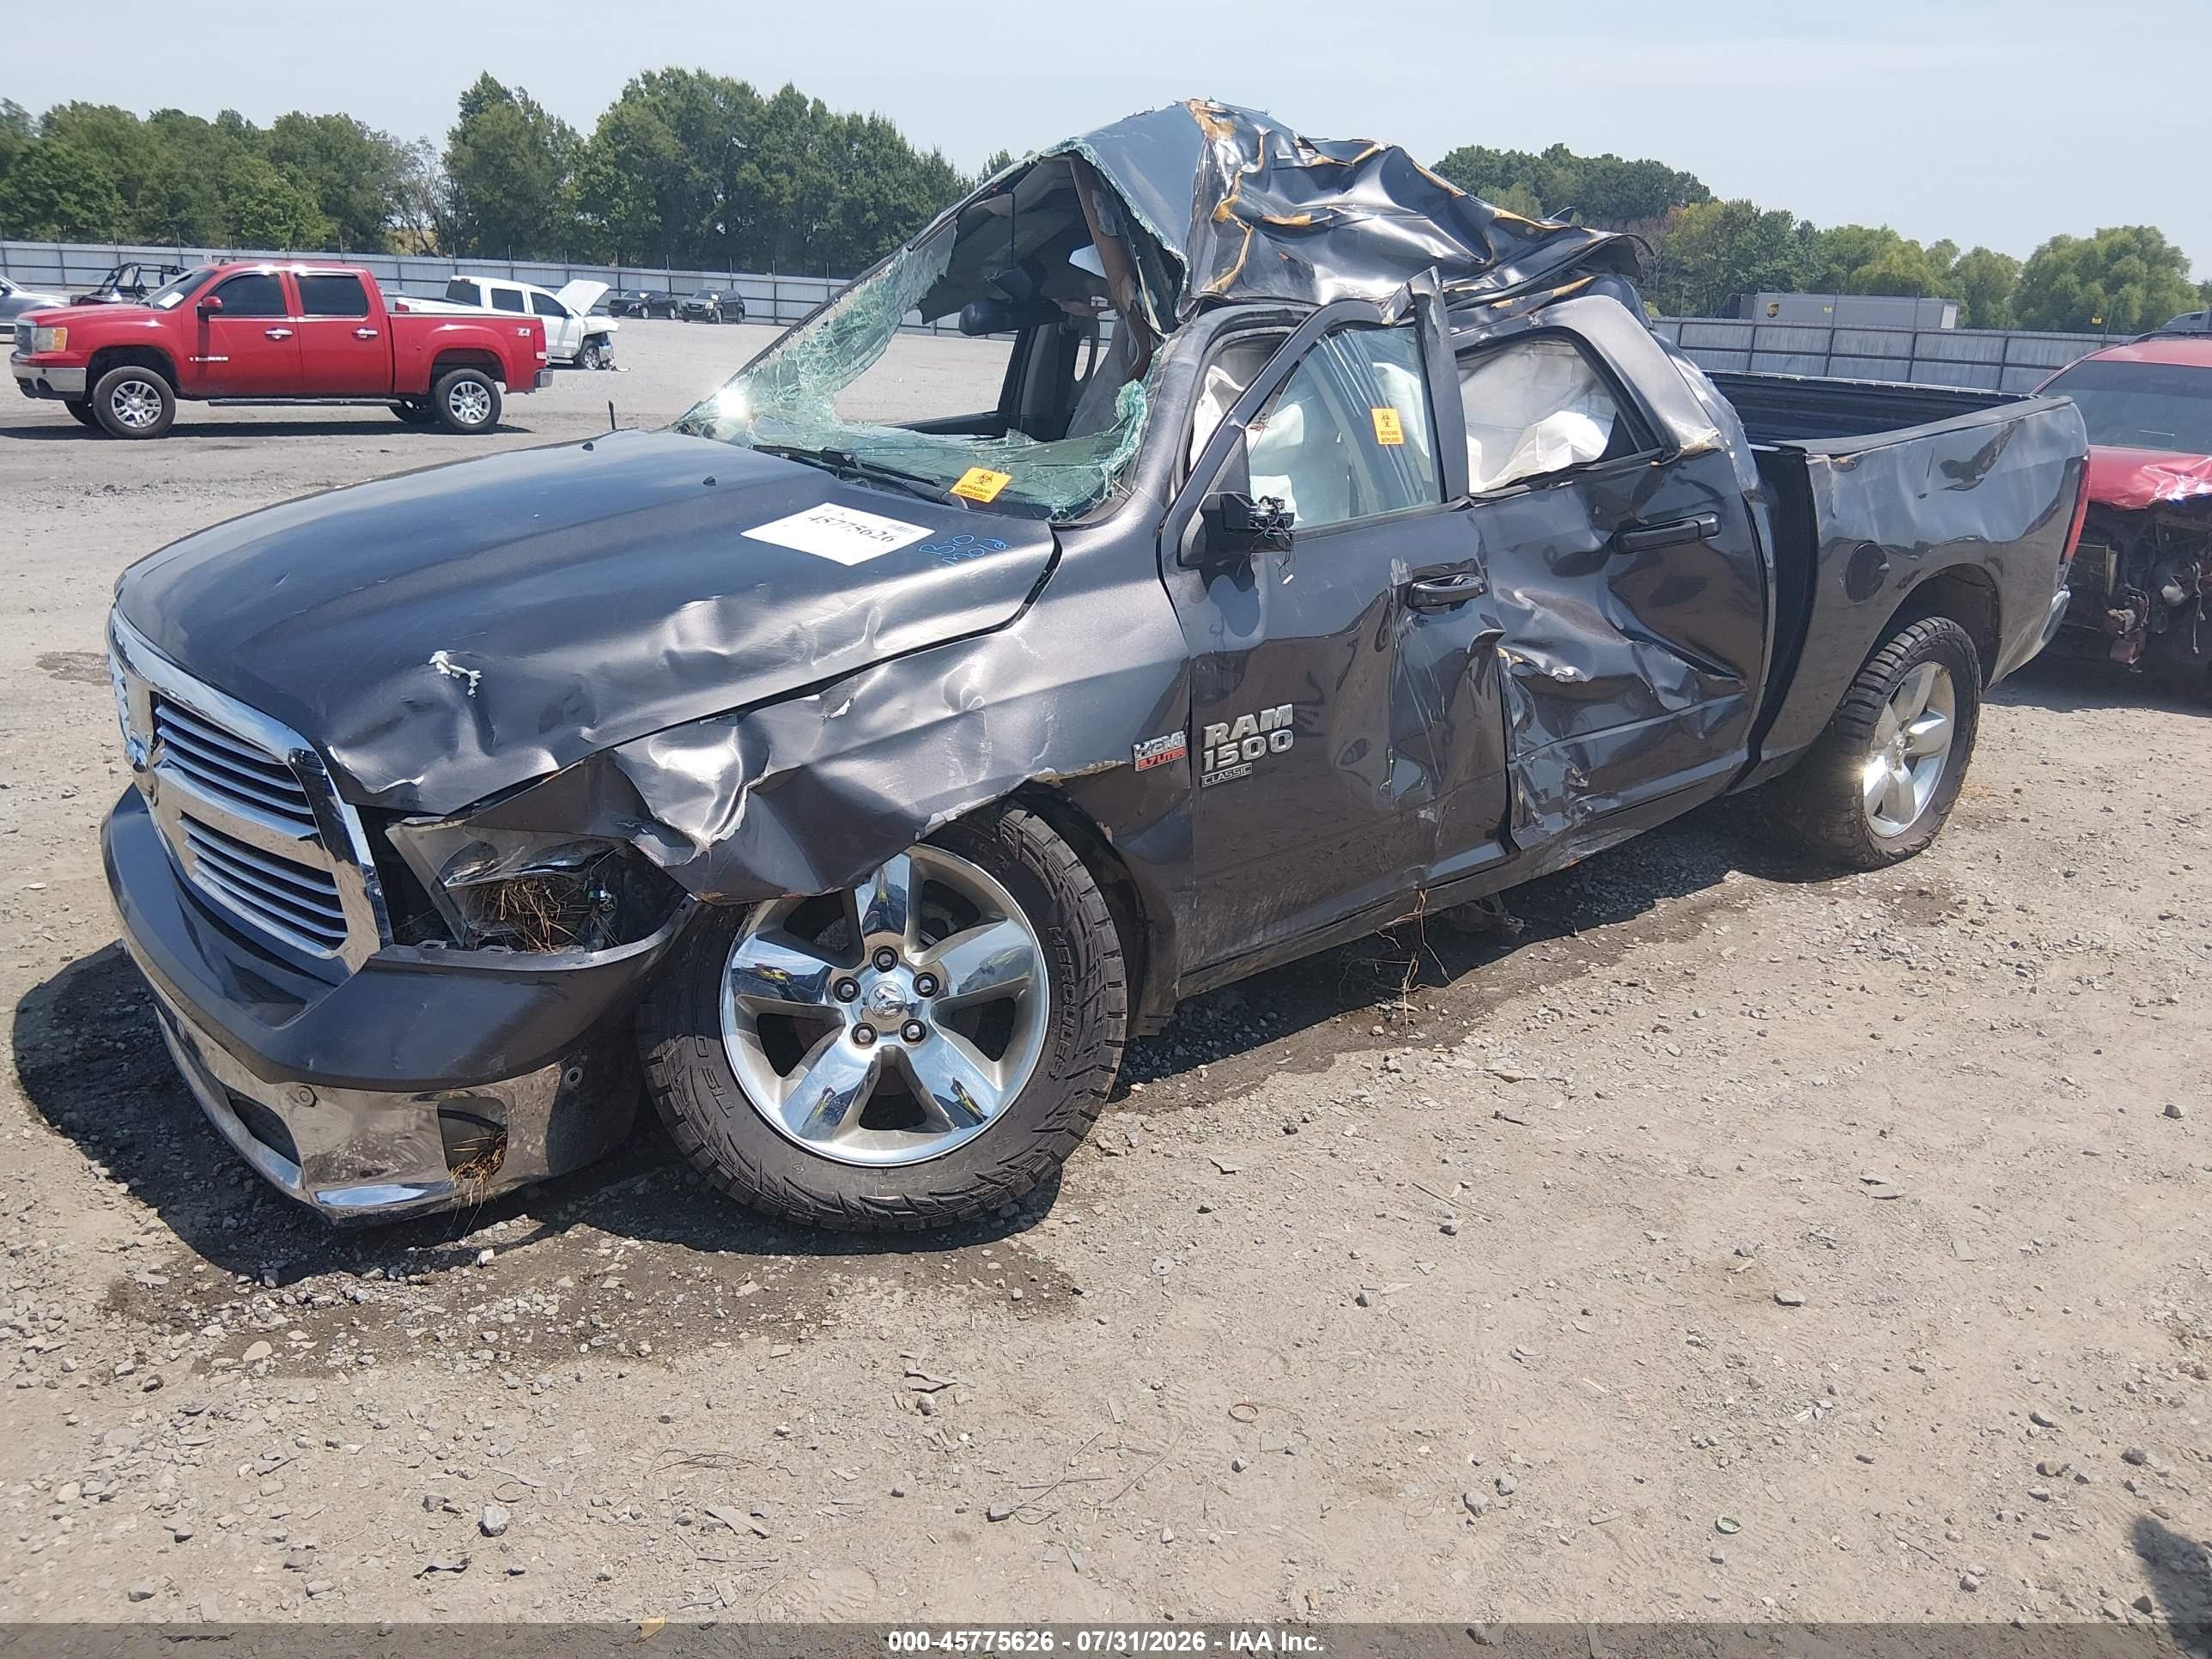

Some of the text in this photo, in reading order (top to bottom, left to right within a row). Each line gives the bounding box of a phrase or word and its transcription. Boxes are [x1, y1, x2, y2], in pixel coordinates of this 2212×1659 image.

[1203, 703, 1293, 748] RAM
[1203, 729, 1294, 772] 1500
[1202, 764, 1252, 787] CLASSIC
[1047, 927, 1076, 1080] HERCULES
